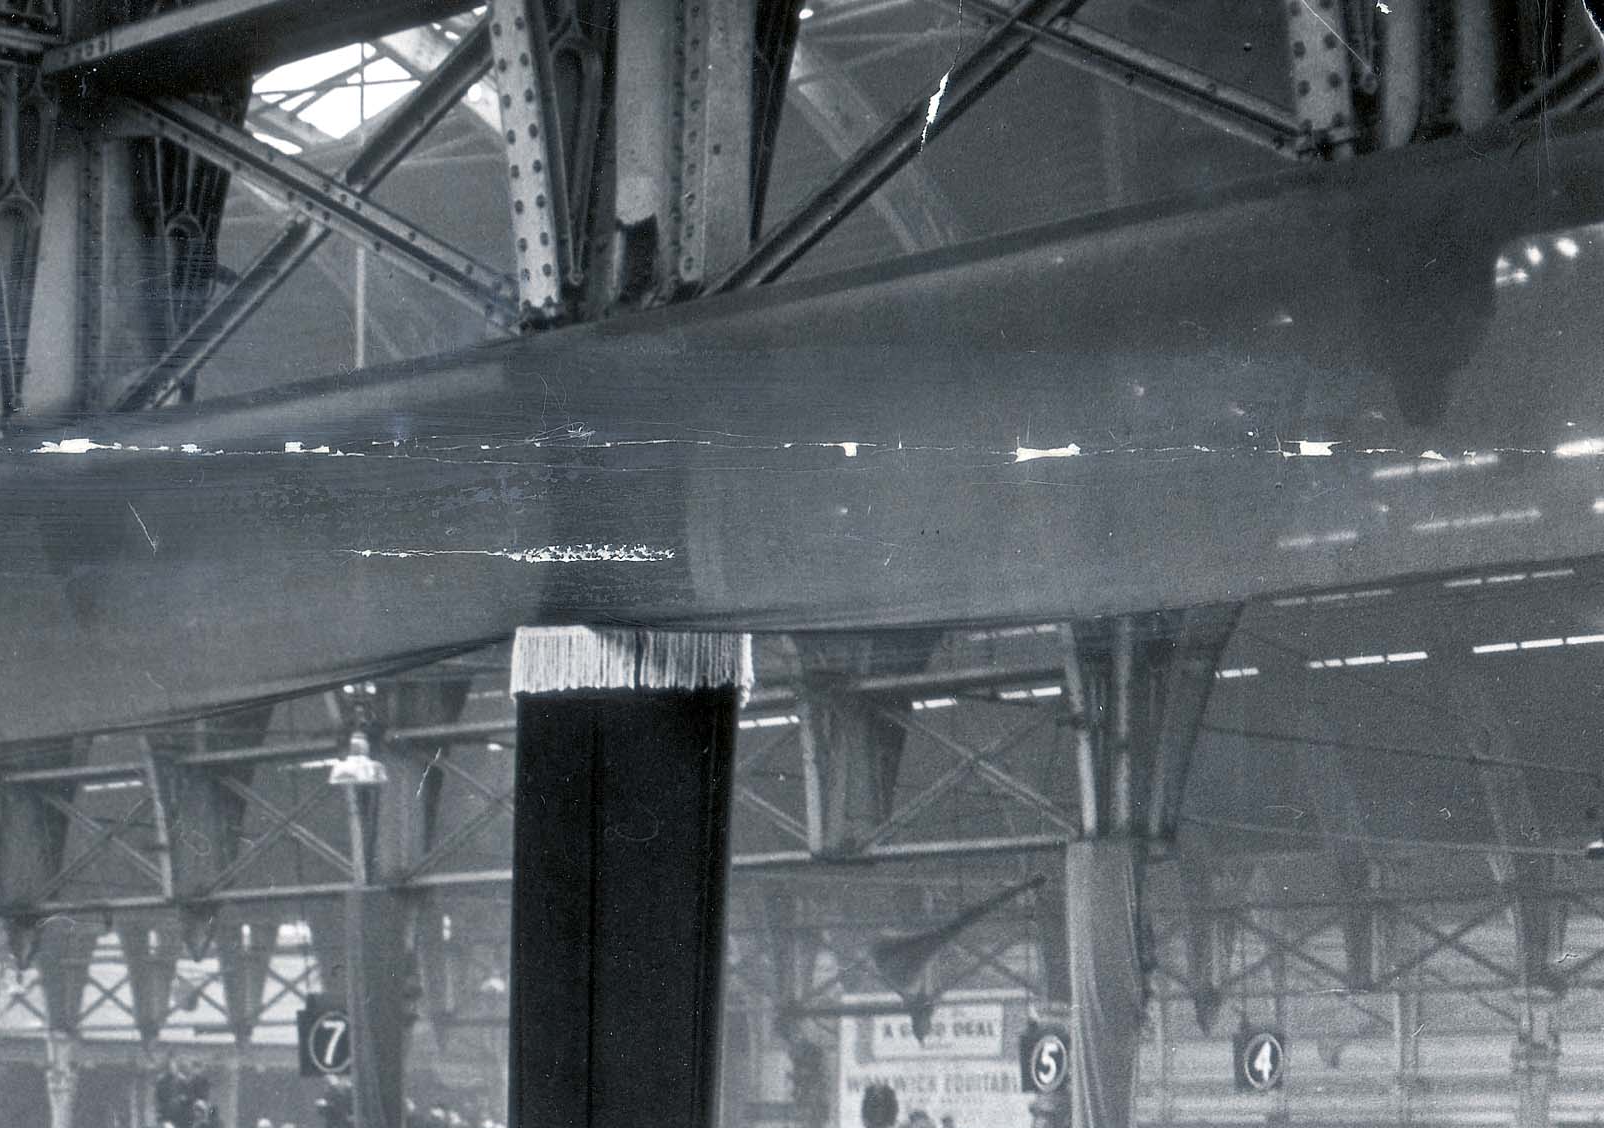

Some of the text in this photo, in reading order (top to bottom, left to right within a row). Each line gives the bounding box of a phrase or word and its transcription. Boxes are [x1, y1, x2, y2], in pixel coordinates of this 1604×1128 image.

[322, 1020, 346, 1065] 7
[883, 1021, 995, 1038] A GD DEAL
[1038, 1041, 1059, 1084] 5
[1254, 1041, 1273, 1081] 4
